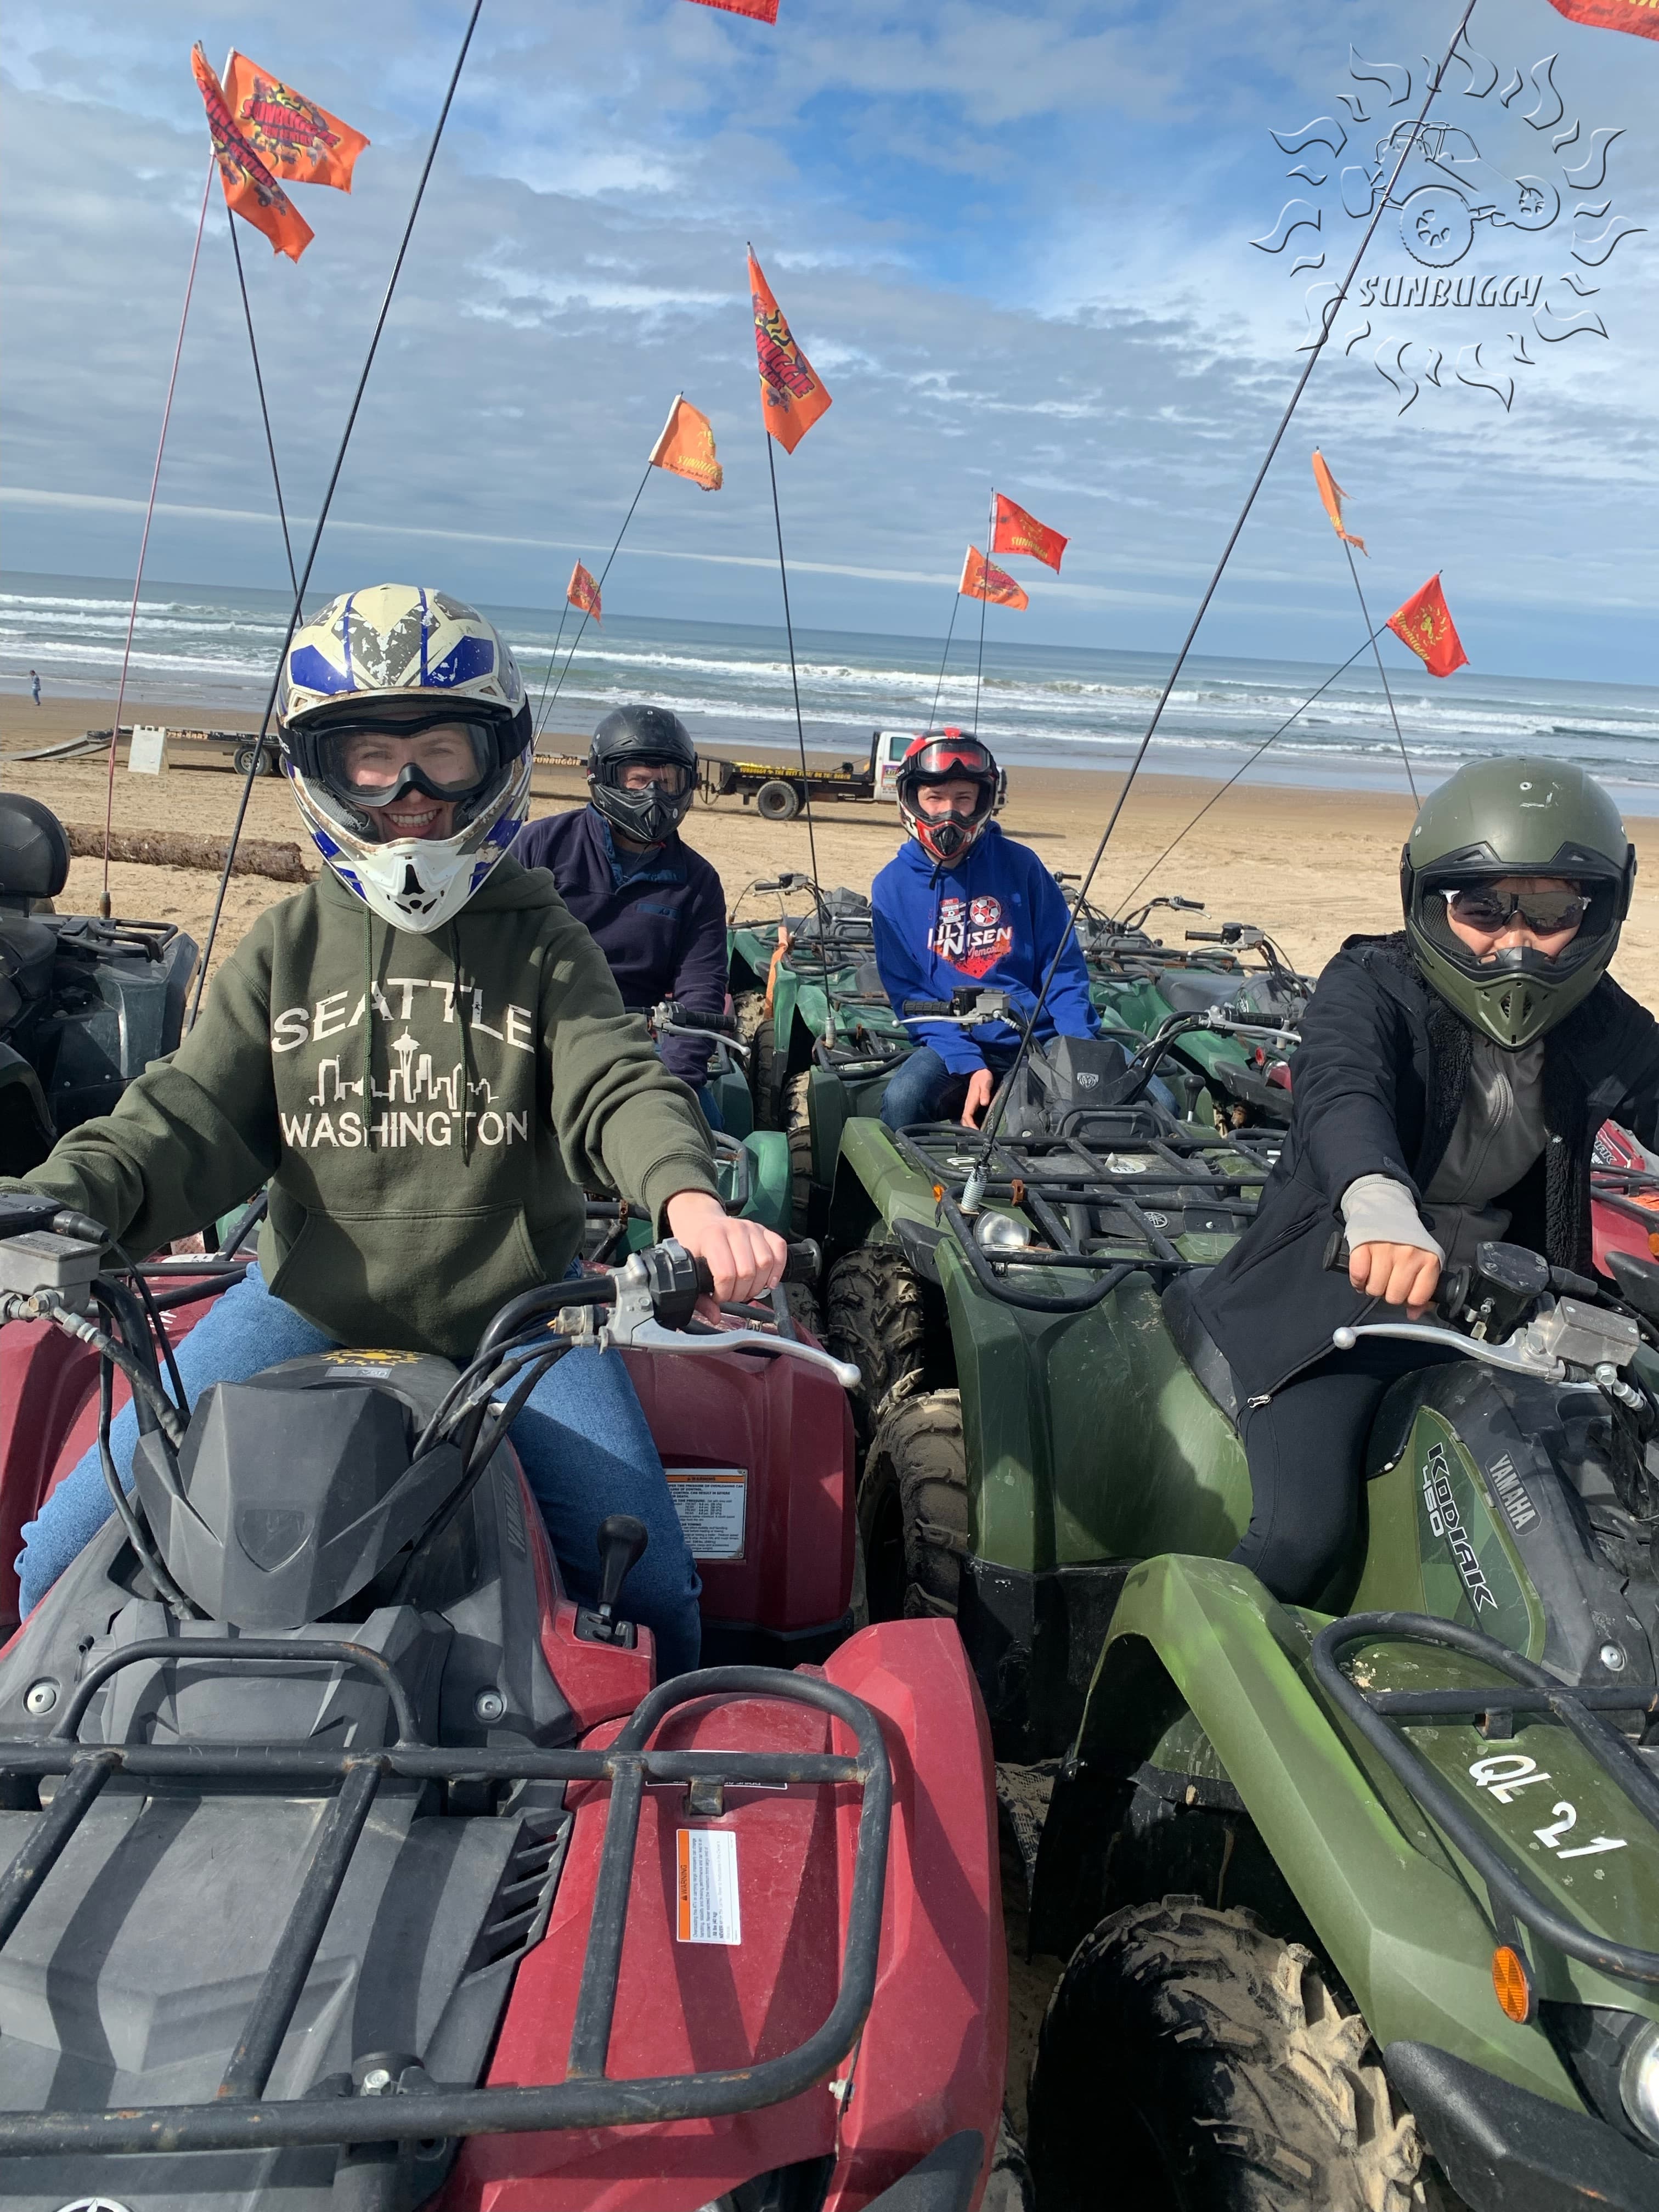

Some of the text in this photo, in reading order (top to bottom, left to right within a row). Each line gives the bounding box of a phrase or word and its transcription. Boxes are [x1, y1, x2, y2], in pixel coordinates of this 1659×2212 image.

[228, 142, 277, 188] RENTALS
[271, 978, 535, 1053] SEATTLE
[280, 1110, 528, 1148] WASHINGTON
[1422, 1465, 1444, 1537] 450
[1427, 1442, 1498, 1612] KODIAK
[1489, 1454, 1536, 1530] YAMAHA
[1469, 1755, 1628, 1859] QL 21
